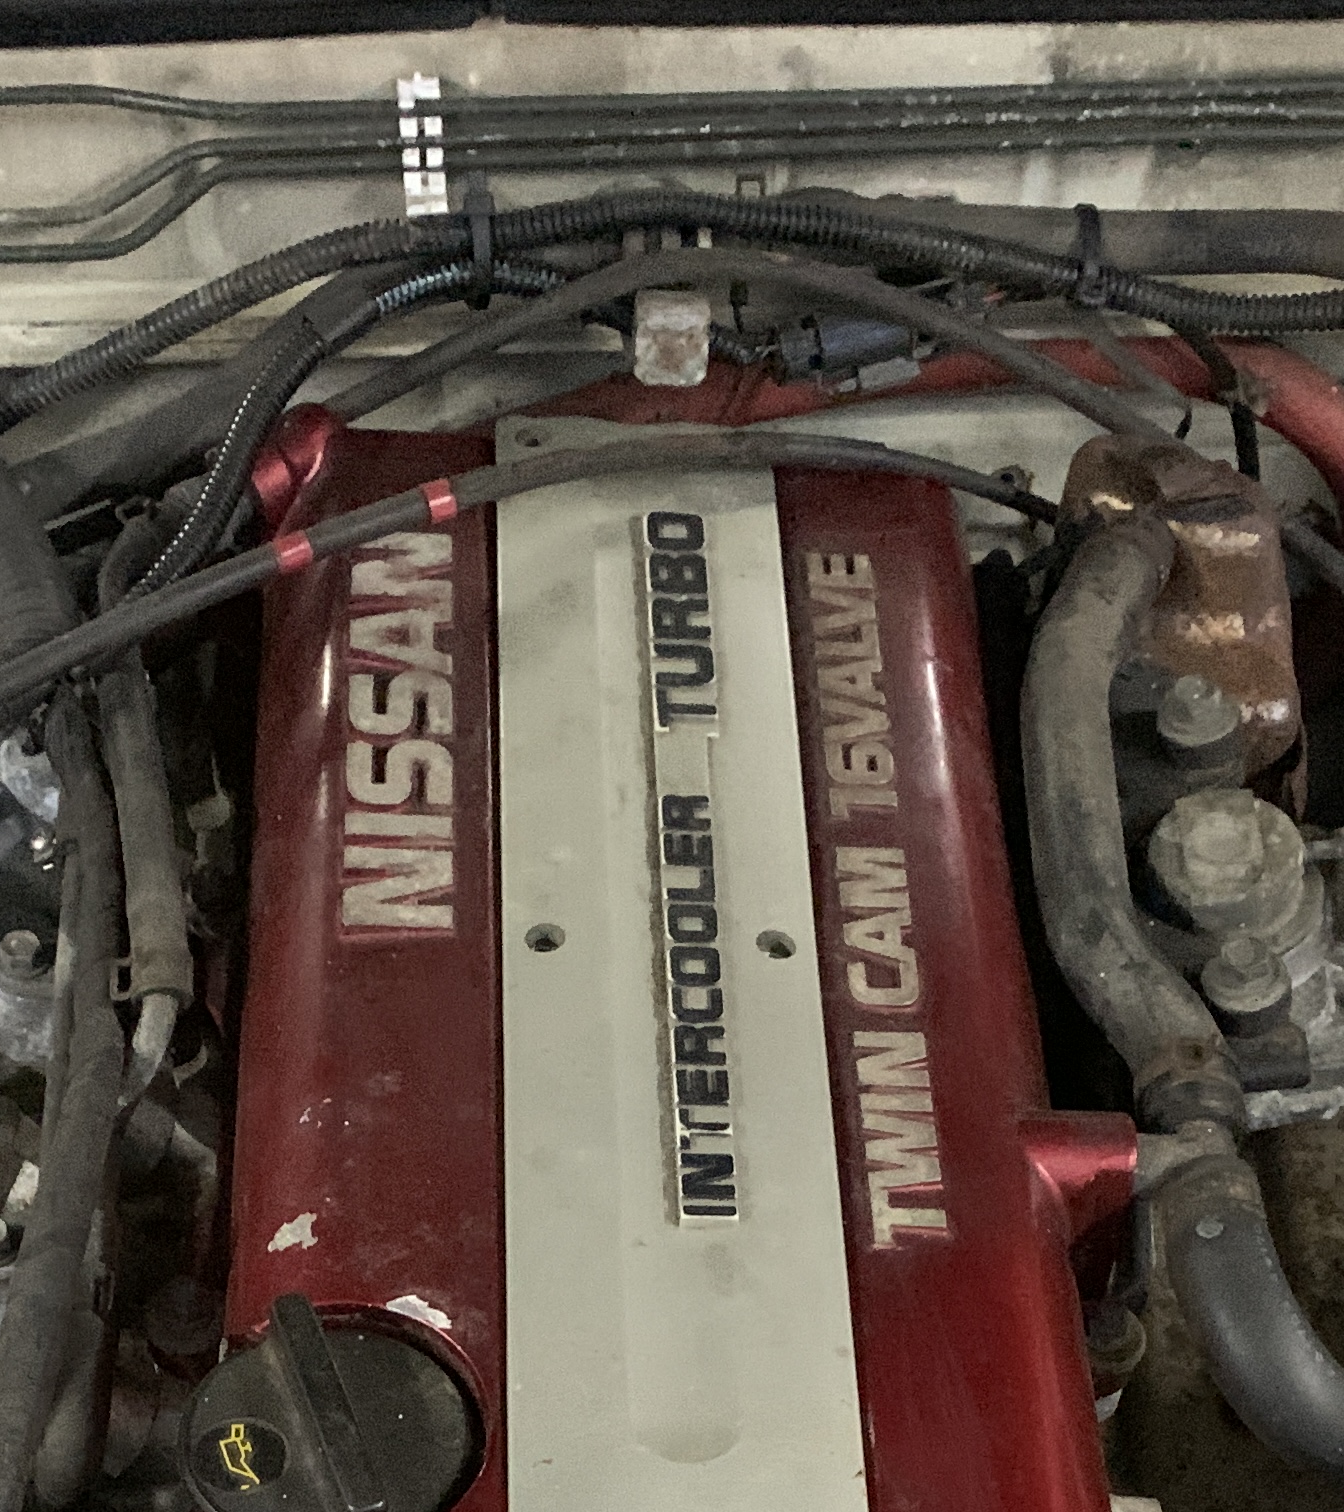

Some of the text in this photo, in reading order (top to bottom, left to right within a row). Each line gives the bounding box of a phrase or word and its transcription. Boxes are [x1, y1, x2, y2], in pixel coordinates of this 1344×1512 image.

[342, 531, 454, 929] NISSAN
[647, 511, 737, 1218] INTERCOOLER TURBO
[836, 846, 921, 1007] CAM
[853, 1031, 948, 1250] TWIN
